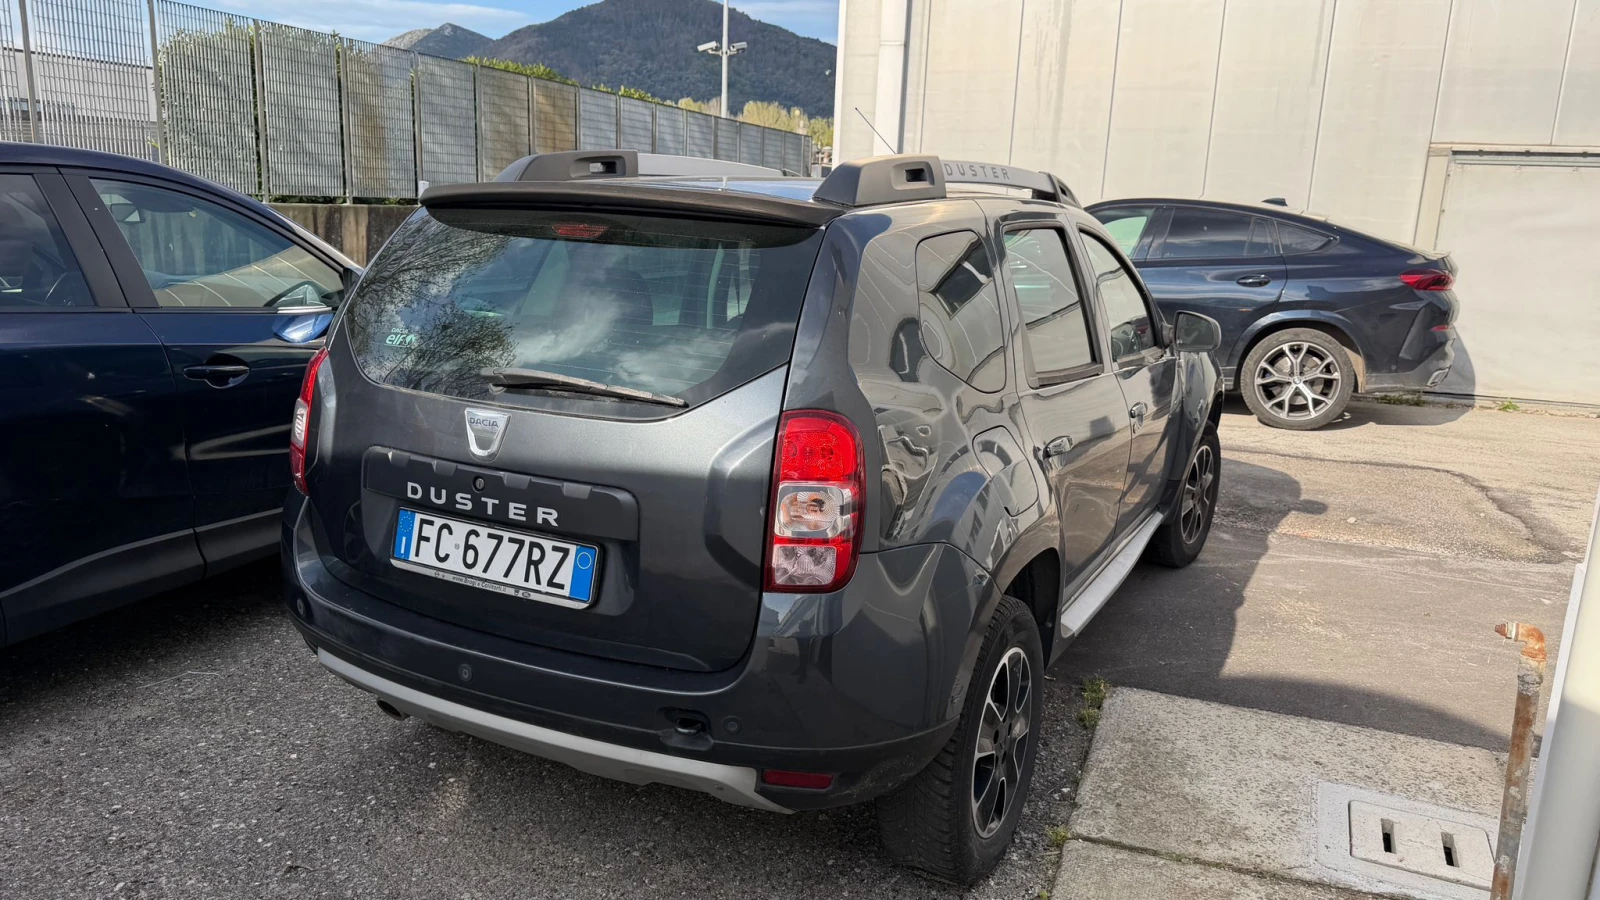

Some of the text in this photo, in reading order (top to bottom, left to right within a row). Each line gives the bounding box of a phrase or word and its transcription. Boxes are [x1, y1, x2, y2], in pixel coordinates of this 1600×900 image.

[943, 163, 1011, 180] DUSTER
[385, 333, 407, 345] elf
[469, 417, 499, 428] DACIA
[406, 481, 559, 527] DUSTER
